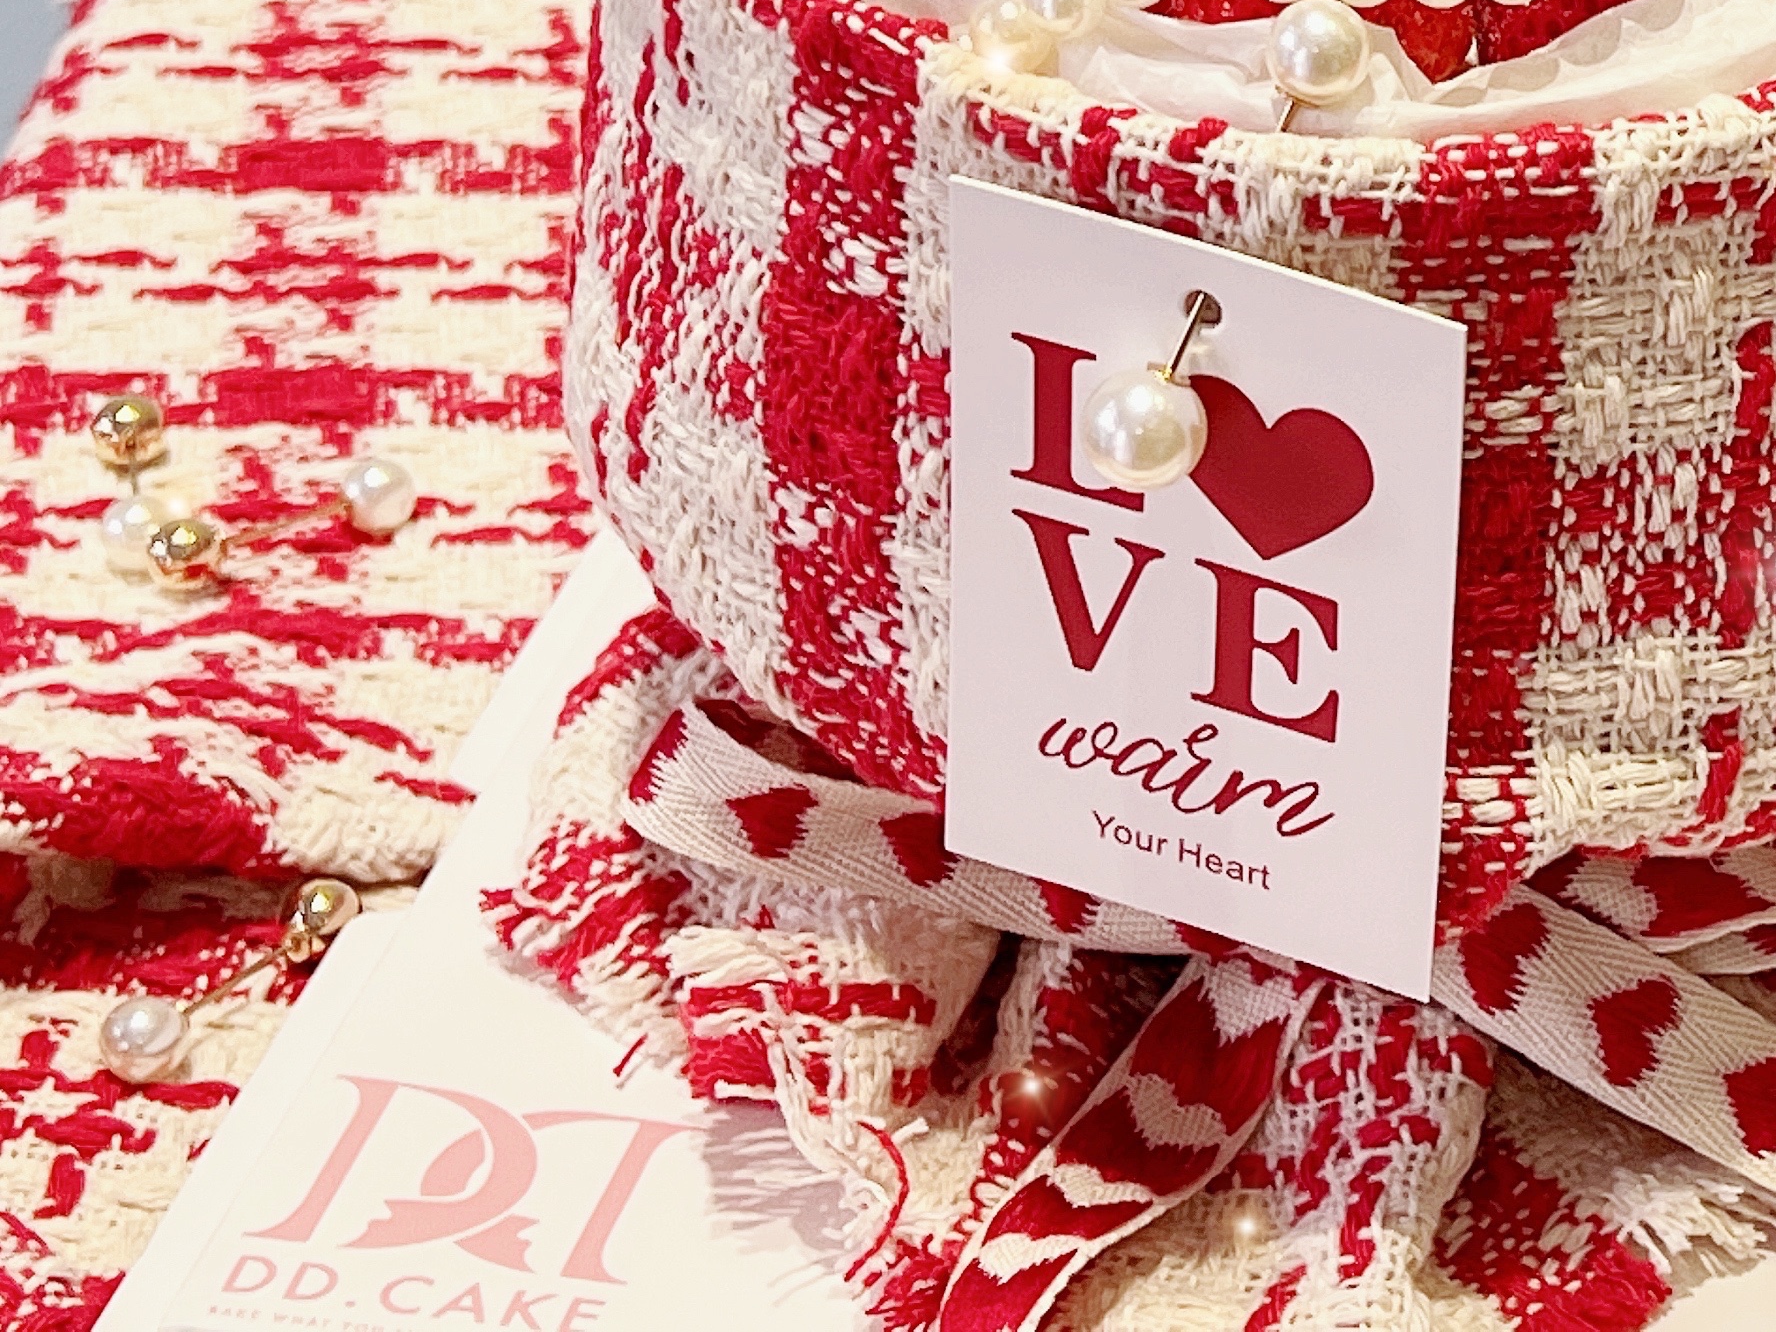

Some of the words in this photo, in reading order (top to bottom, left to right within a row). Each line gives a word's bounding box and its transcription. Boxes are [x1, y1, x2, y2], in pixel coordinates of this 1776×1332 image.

[1038, 717, 1335, 837] warm
[1092, 810, 1169, 856] Your
[1178, 837, 1271, 891] Heart
